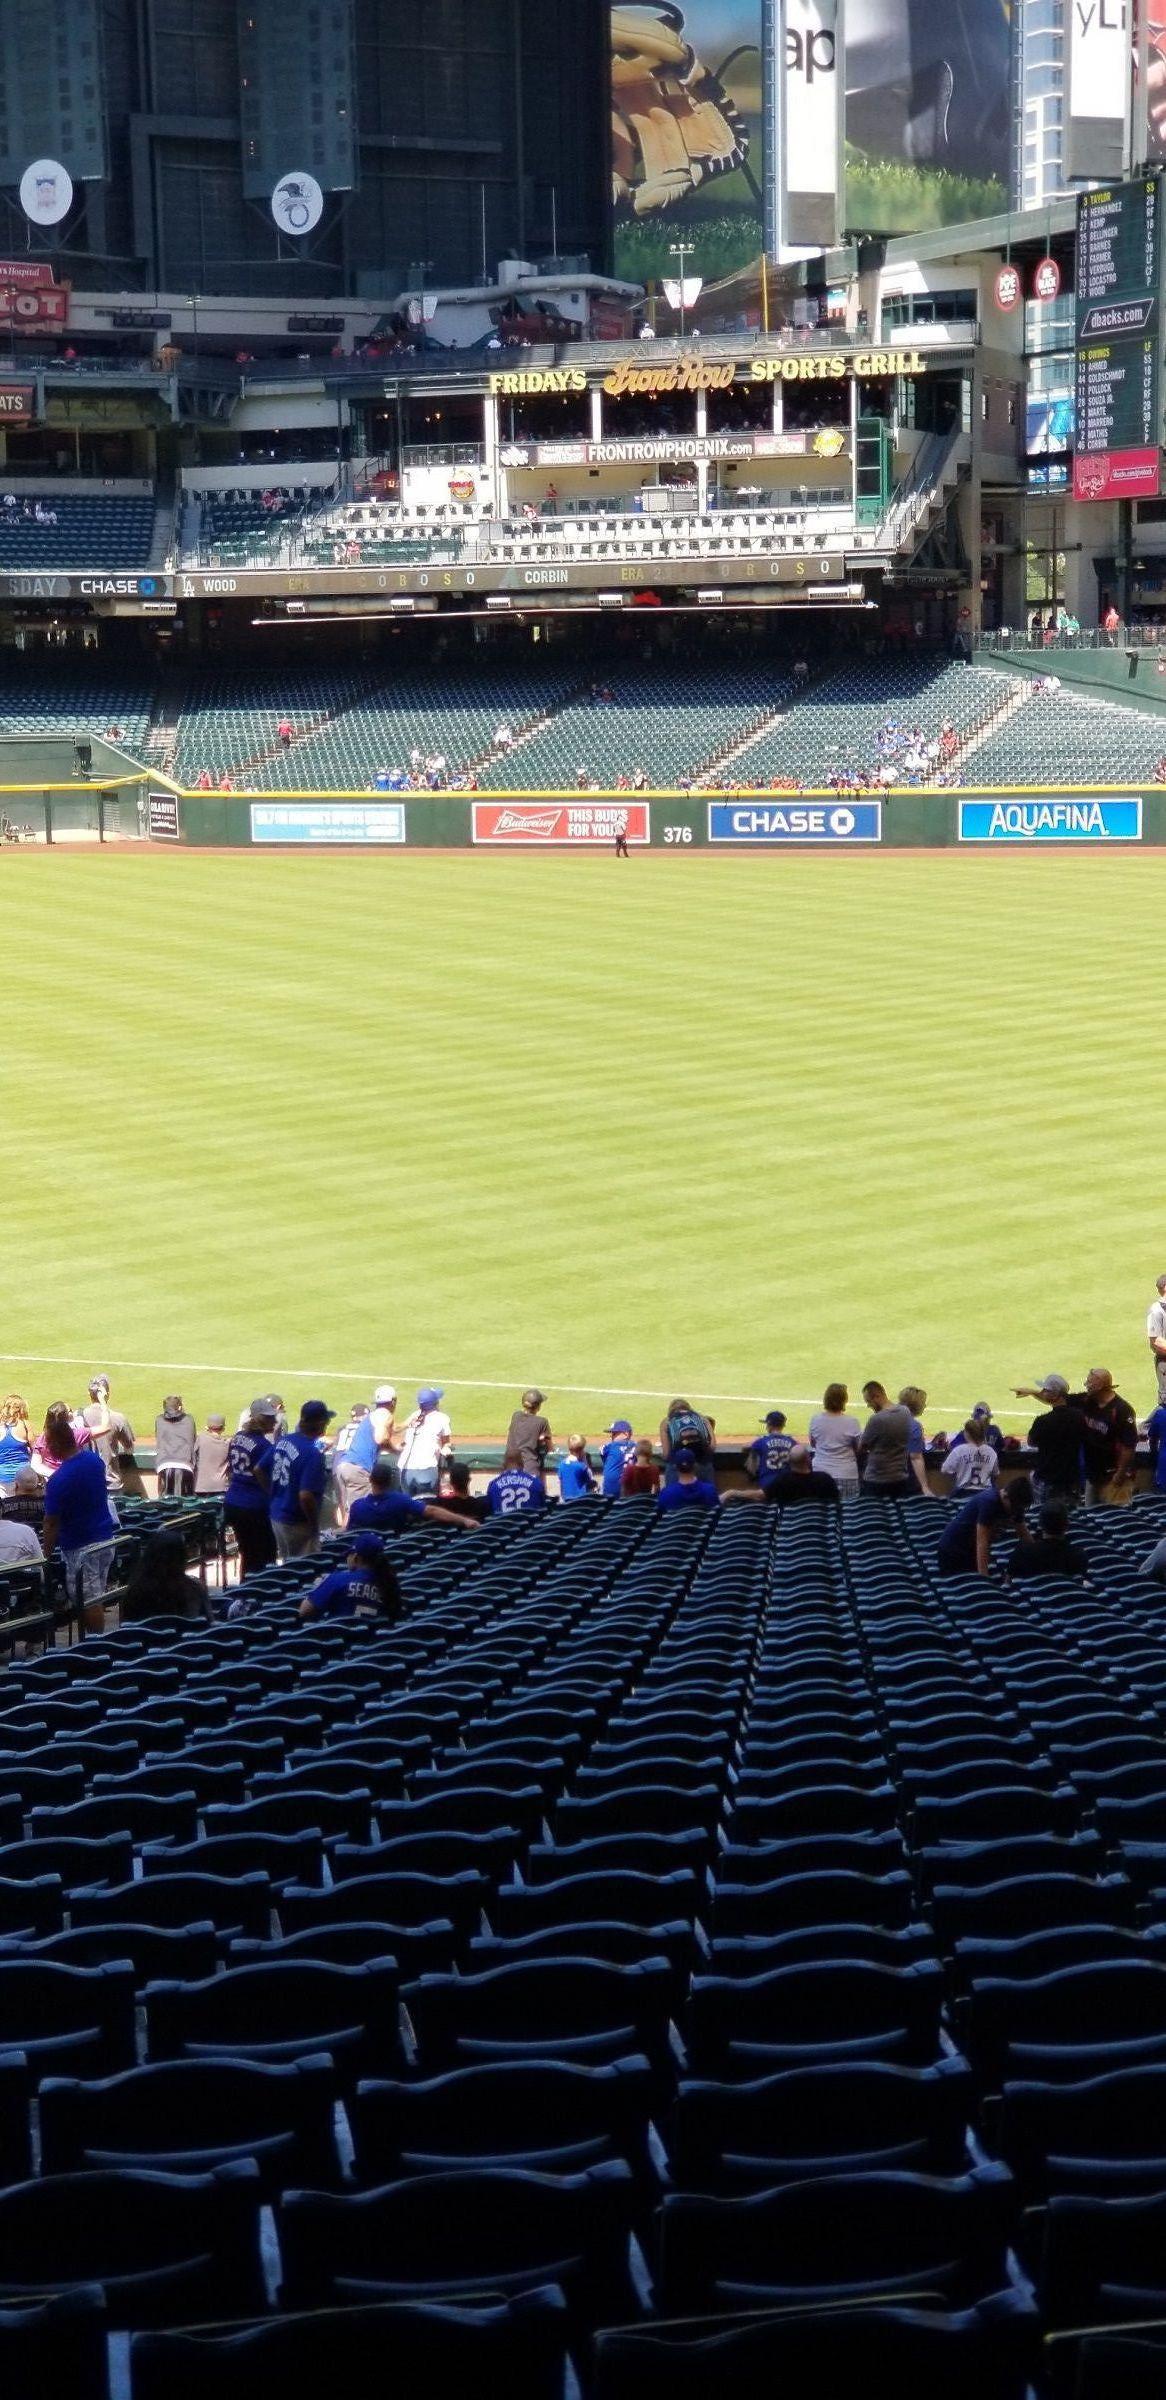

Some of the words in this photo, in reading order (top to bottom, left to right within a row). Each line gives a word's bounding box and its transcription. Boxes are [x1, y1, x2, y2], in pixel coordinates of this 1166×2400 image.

[1083, 197, 1088, 206] 3
[1090, 192, 1112, 205] TAYLOR
[1146, 182, 1155, 193] SS
[1080, 208, 1088, 219] 14
[1080, 221, 1087, 231] 27
[1090, 217, 1106, 229] KEMP
[1146, 206, 1154, 217] RF
[1080, 233, 1087, 243] 35
[1089, 226, 1118, 241] BELLINGER
[1080, 244, 1087, 254] 15
[1089, 240, 1112, 253] BARNES
[1079, 267, 1086, 277] 61
[1146, 254, 1153, 265] LF
[1080, 255, 1087, 266] 17
[1089, 251, 1112, 263] FARMER
[8, 267, 40, 277] Hospital
[1079, 278, 1087, 288] 70
[1089, 273, 1117, 287] LOCASTRO
[1079, 289, 1086, 299] 57
[1089, 285, 1105, 297] WOOD
[1091, 308, 1143, 328] dbacks.com
[1079, 351, 1086, 361] 16
[489, 369, 587, 395] FRIDAY'S
[604, 356, 681, 395] Front
[675, 353, 736, 390] Row
[751, 356, 846, 382] SPORTS
[854, 352, 926, 375] GRILL
[1079, 363, 1086, 373] 13
[1088, 360, 1108, 372] AHMED
[1078, 375, 1086, 384] 44
[1079, 387, 1085, 396] 11
[1088, 383, 1112, 395] POLLOCK
[1088, 395, 1106, 406] SOUZA
[1088, 406, 1107, 417] MARTE
[1081, 430, 1086, 440] 2
[588, 439, 753, 461] FRONTROWPHOENIX.com
[1088, 439, 1108, 449] CORBIN
[203, 578, 237, 592] WOOD
[524, 570, 569, 583] CORBIN
[621, 567, 644, 581] ERA
[796, 562, 805, 575] S
[81, 579, 138, 594] CHASE
[567, 808, 593, 822] THIS
[733, 811, 826, 832] CHASE
[988, 803, 1109, 837] AQUAFINA
[567, 823, 590, 837] FOR
[663, 827, 693, 843] 376
[496, 1474, 533, 1488] KERSHAW
[501, 1487, 531, 1513] 22
[347, 1582, 383, 1603] SEAG
